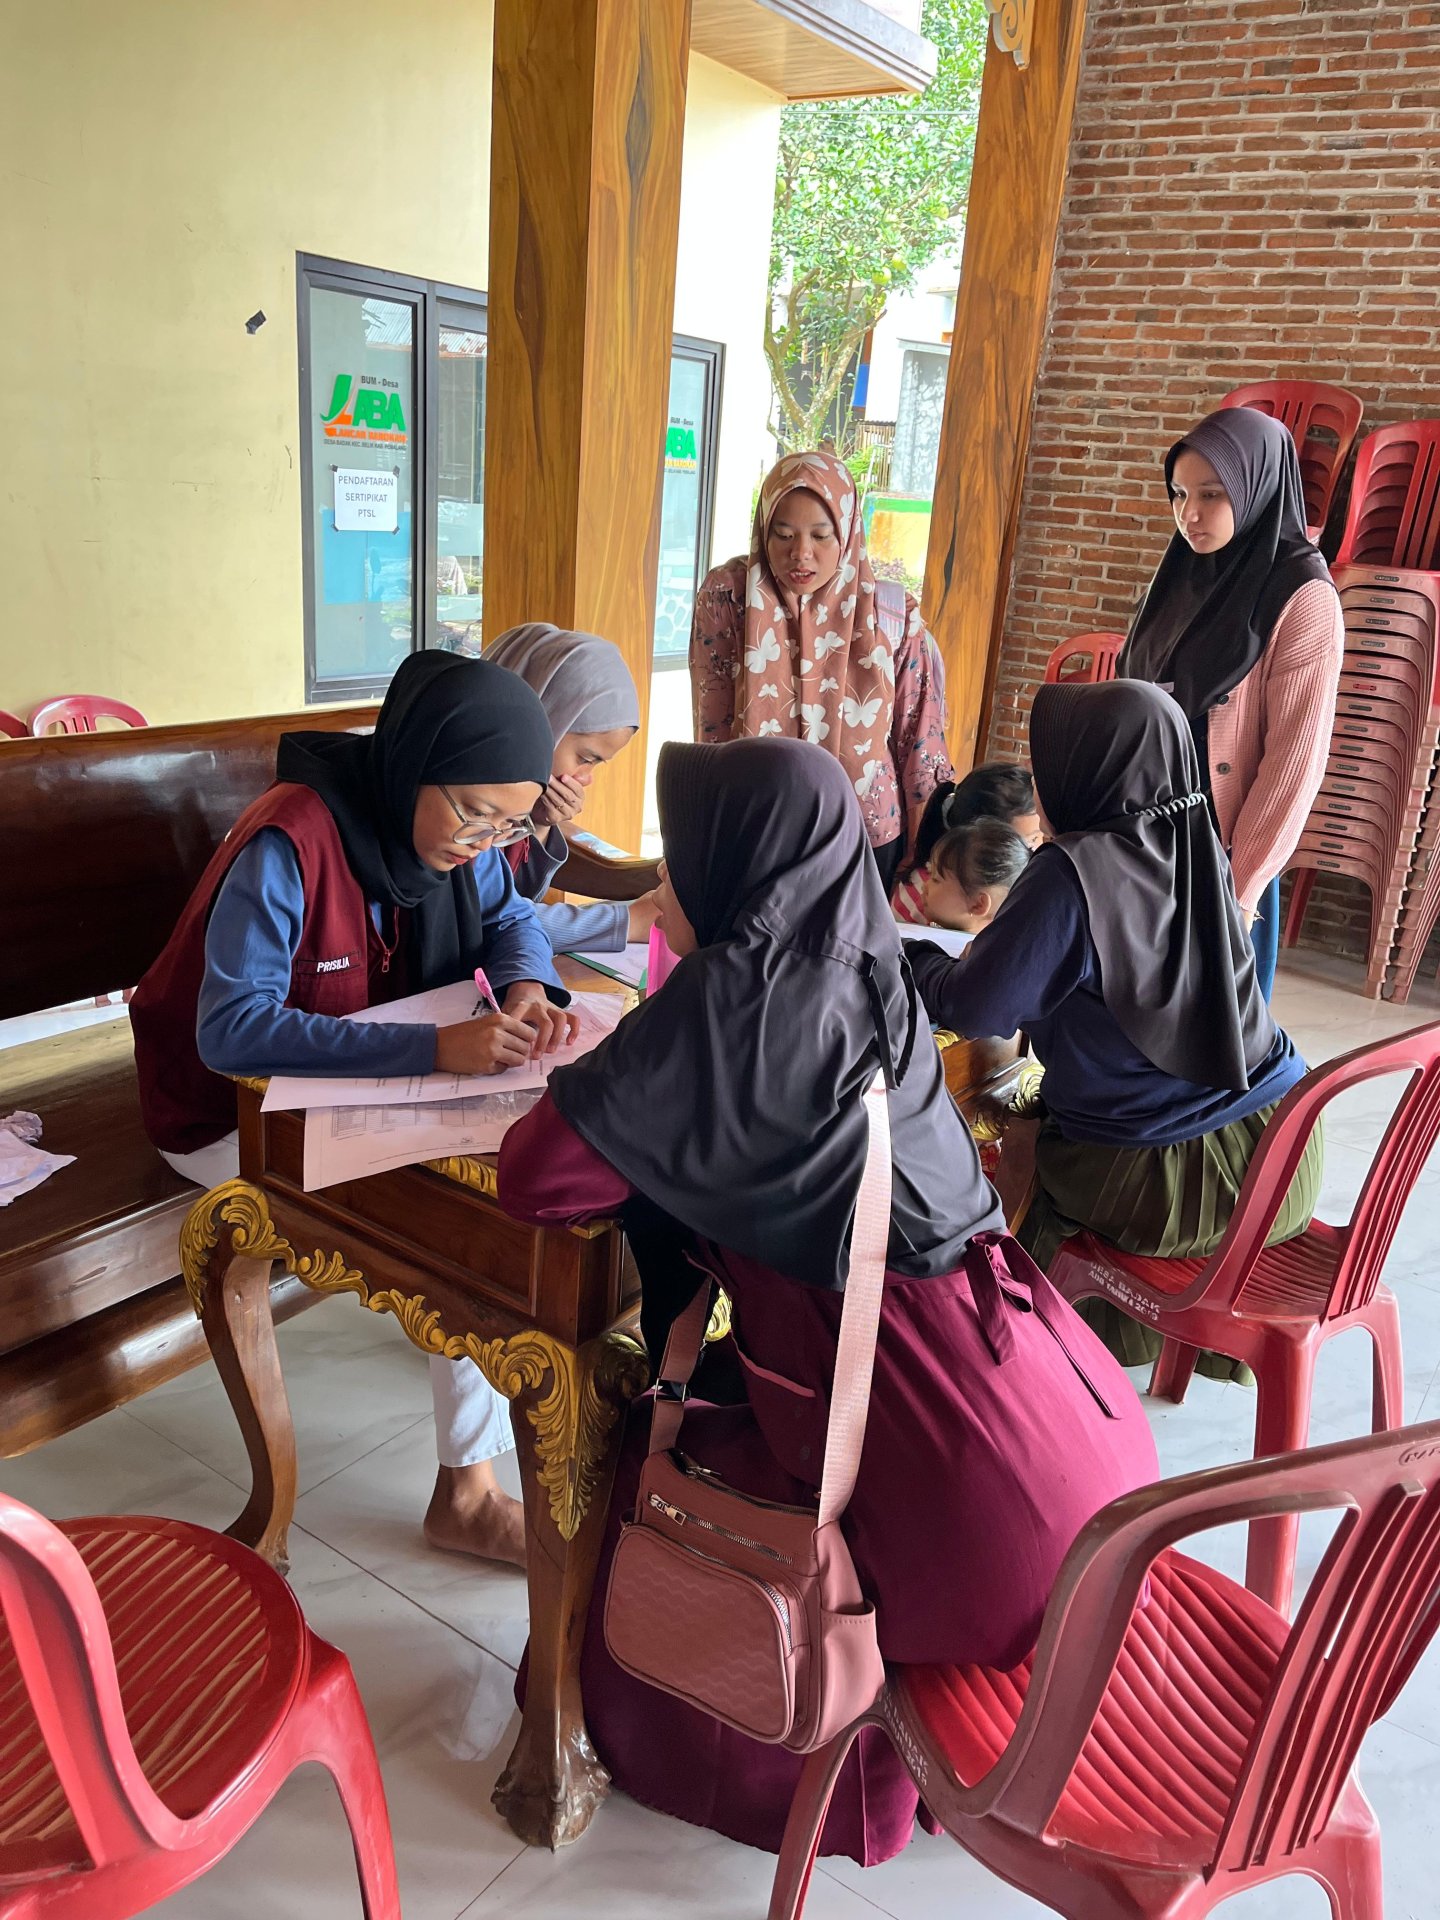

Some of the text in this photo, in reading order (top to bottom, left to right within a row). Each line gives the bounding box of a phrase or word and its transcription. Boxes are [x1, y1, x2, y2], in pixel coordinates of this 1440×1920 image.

[361, 375, 377, 385] BUM
[382, 378, 399, 389] Desa
[666, 428, 696, 459] ABA
[338, 475, 394, 487] PENDAFTARAN
[345, 492, 388, 503] SERTIPIKAT
[358, 509, 376, 518] PTSL
